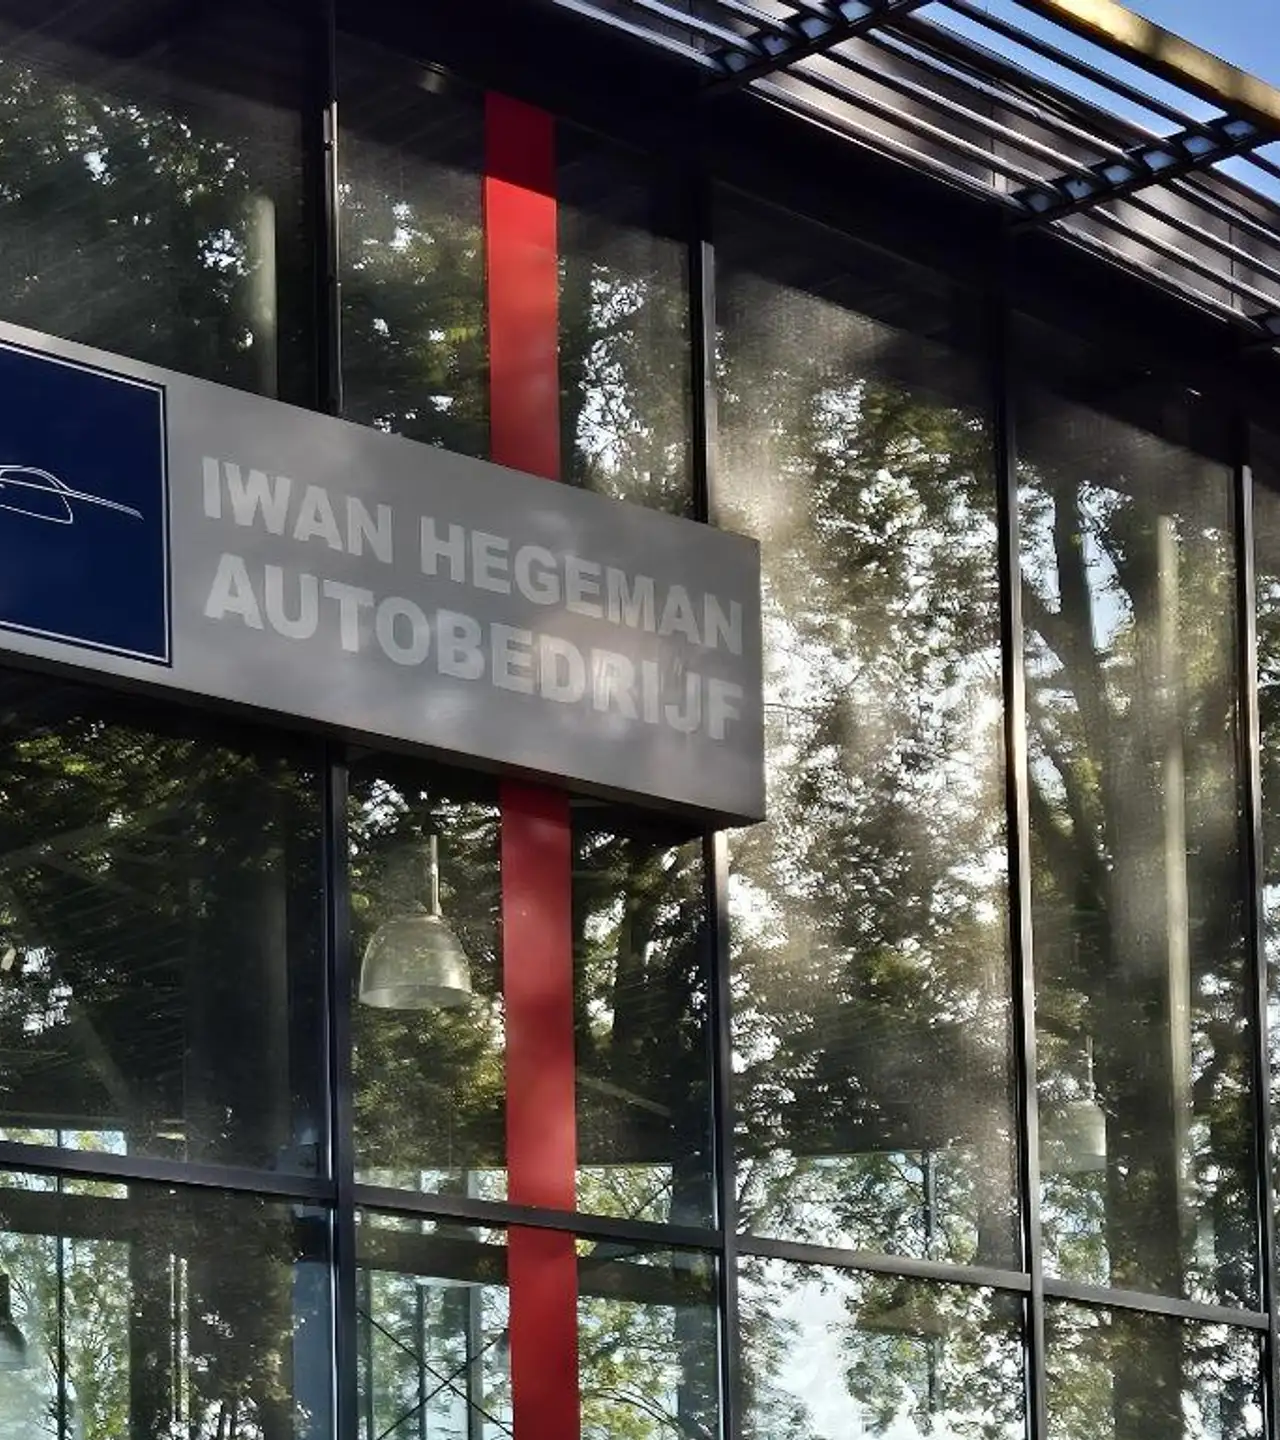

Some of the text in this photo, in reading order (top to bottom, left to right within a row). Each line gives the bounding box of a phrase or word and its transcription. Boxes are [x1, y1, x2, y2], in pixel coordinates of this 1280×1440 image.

[202, 457, 742, 655] IWAN HEGEMAN
[203, 552, 744, 741] AUTOBEDRIJF
